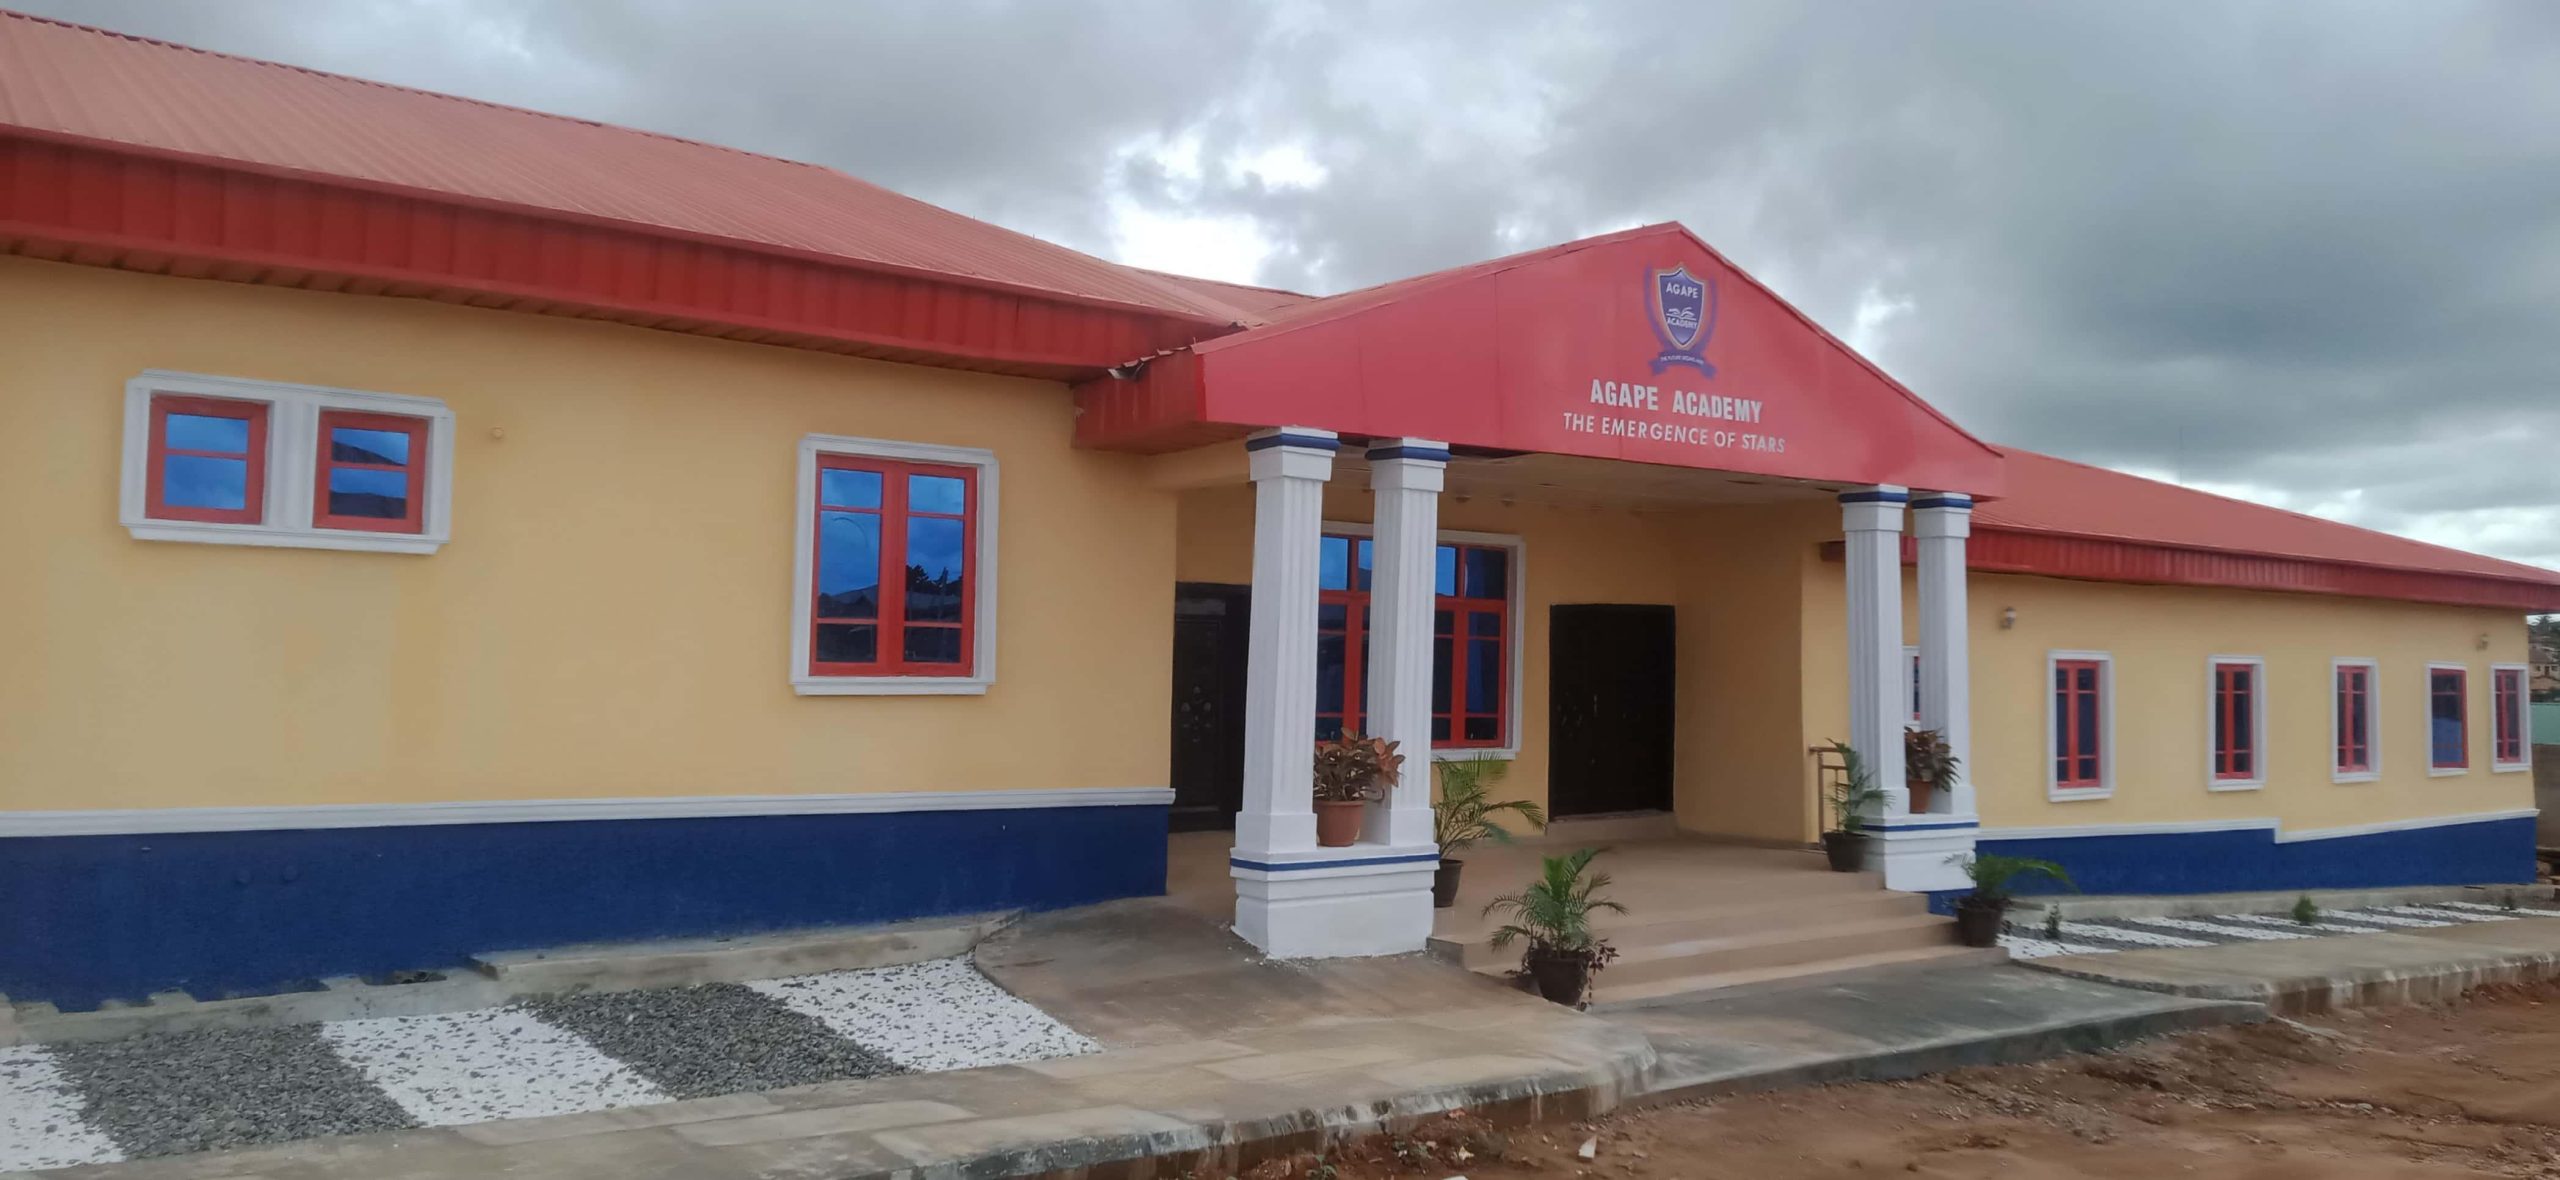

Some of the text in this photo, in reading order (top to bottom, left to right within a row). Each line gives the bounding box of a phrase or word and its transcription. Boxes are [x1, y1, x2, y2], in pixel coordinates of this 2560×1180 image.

[1666, 282, 1698, 298] AGAPE
[1667, 317, 1698, 329] ACADEMY
[1590, 379, 1763, 423] AGAPE ACADEMY
[1563, 412, 1785, 453] THE EMERGENCE OF STARS
